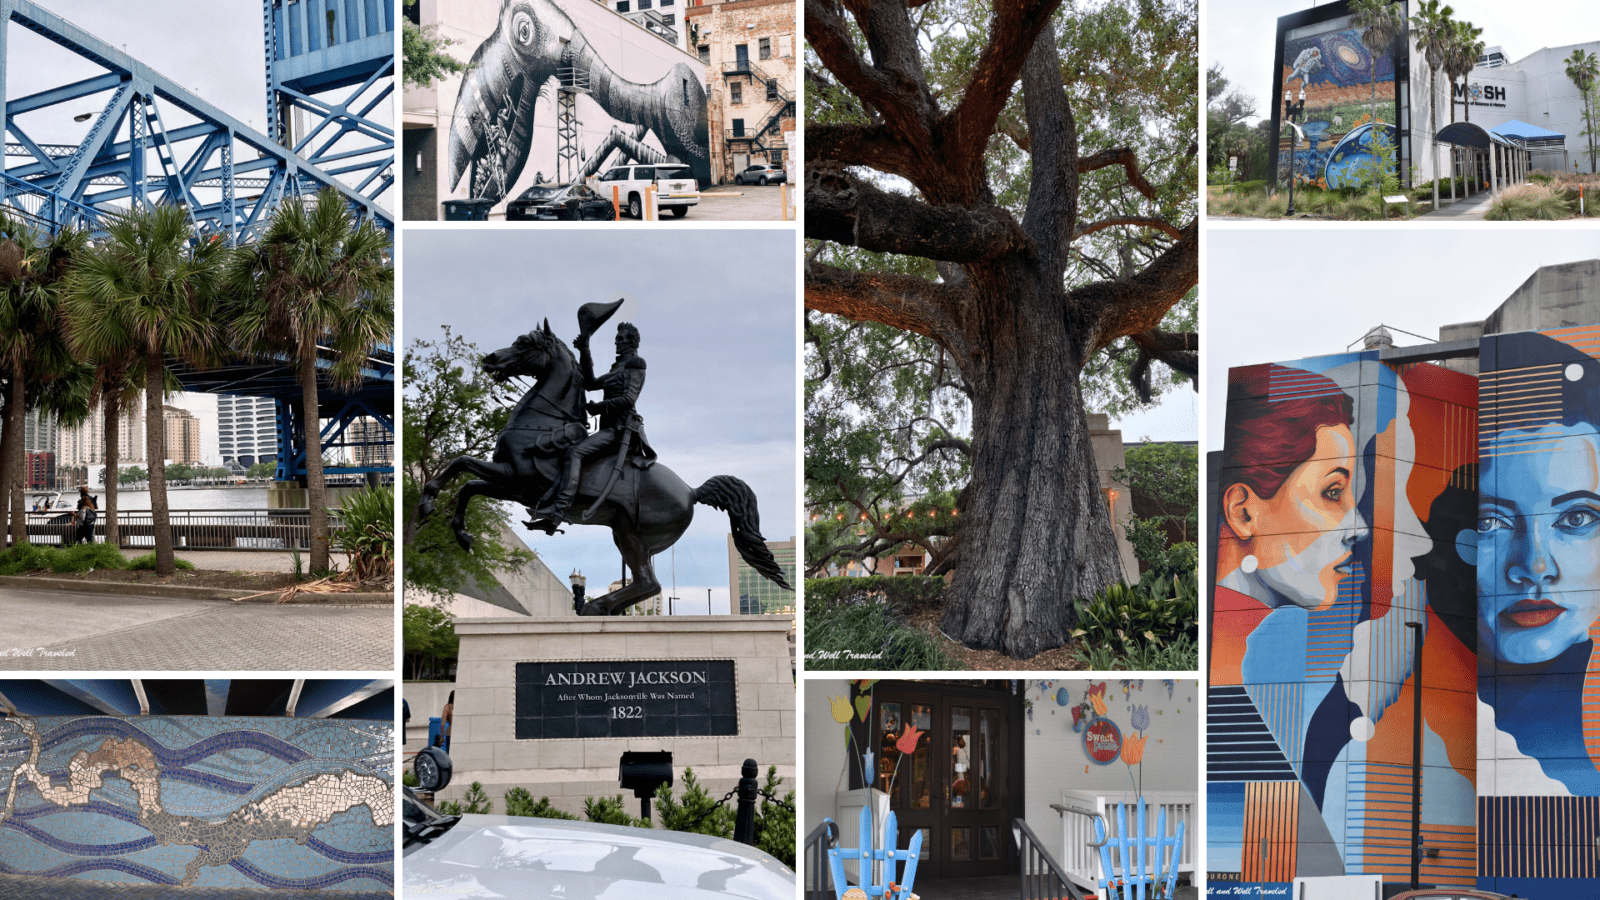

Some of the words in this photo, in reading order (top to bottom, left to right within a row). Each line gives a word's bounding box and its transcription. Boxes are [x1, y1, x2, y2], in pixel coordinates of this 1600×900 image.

[545, 672, 625, 686] ANDREW
[628, 671, 707, 688] JACKSON
[557, 693, 577, 702] After
[577, 693, 603, 701] Whom
[603, 692, 649, 703] Jacksonville
[650, 692, 666, 701] Was
[666, 691, 695, 700] Named
[610, 706, 643, 720] 1822
